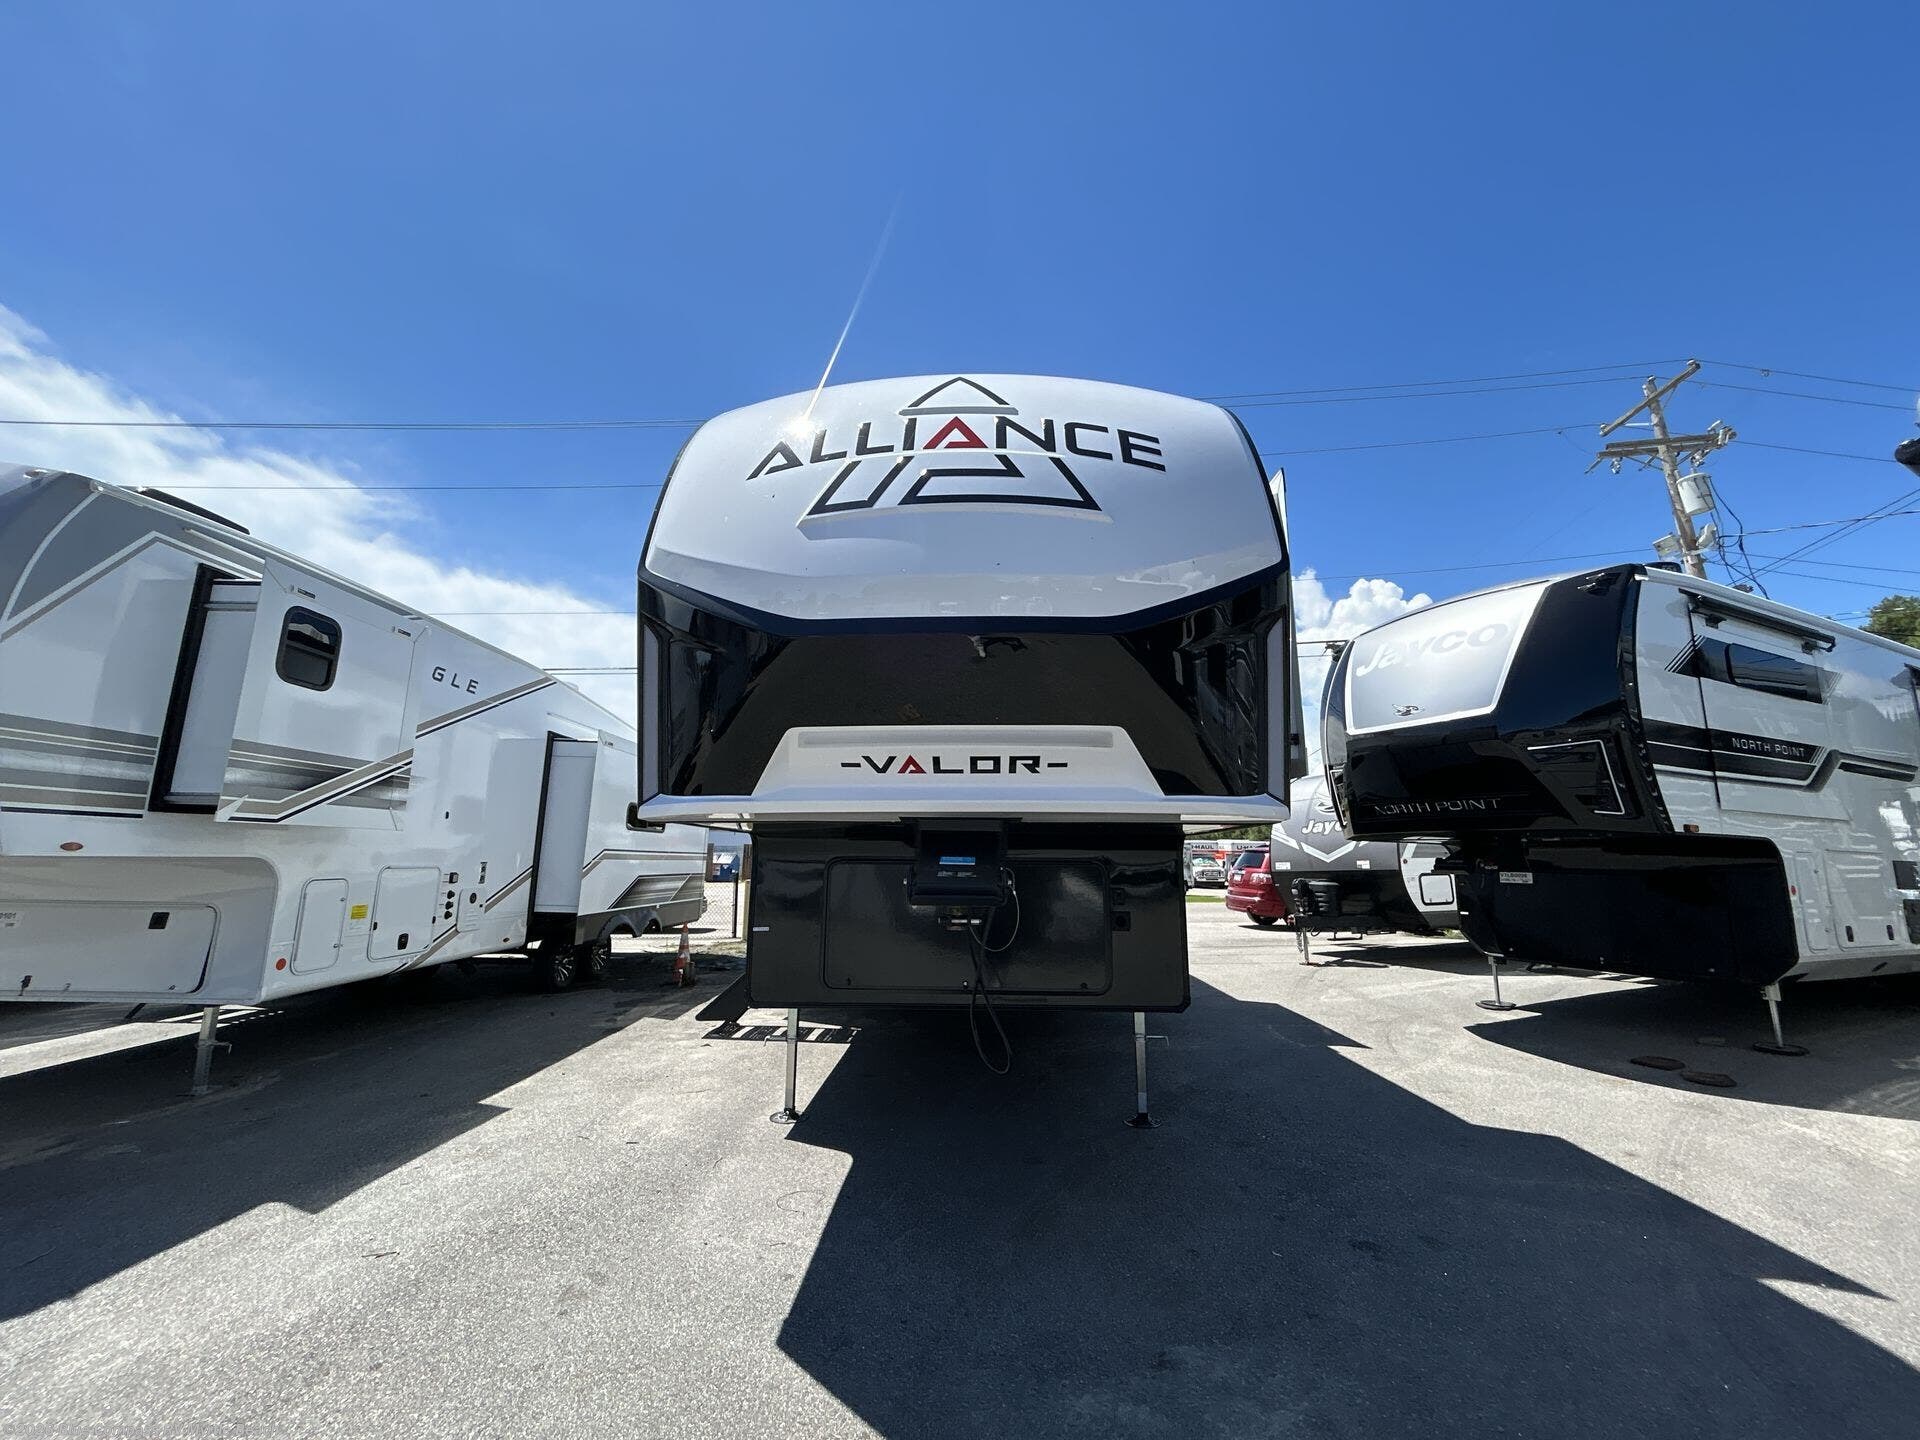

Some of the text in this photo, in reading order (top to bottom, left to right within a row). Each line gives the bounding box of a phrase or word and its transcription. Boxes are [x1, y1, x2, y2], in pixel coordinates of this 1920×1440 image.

[746, 415, 1167, 482] ALLIANCE
[431, 666, 479, 695] GLE
[1731, 737, 1804, 757] NORTH POINT
[1434, 798, 1501, 812] POINT
